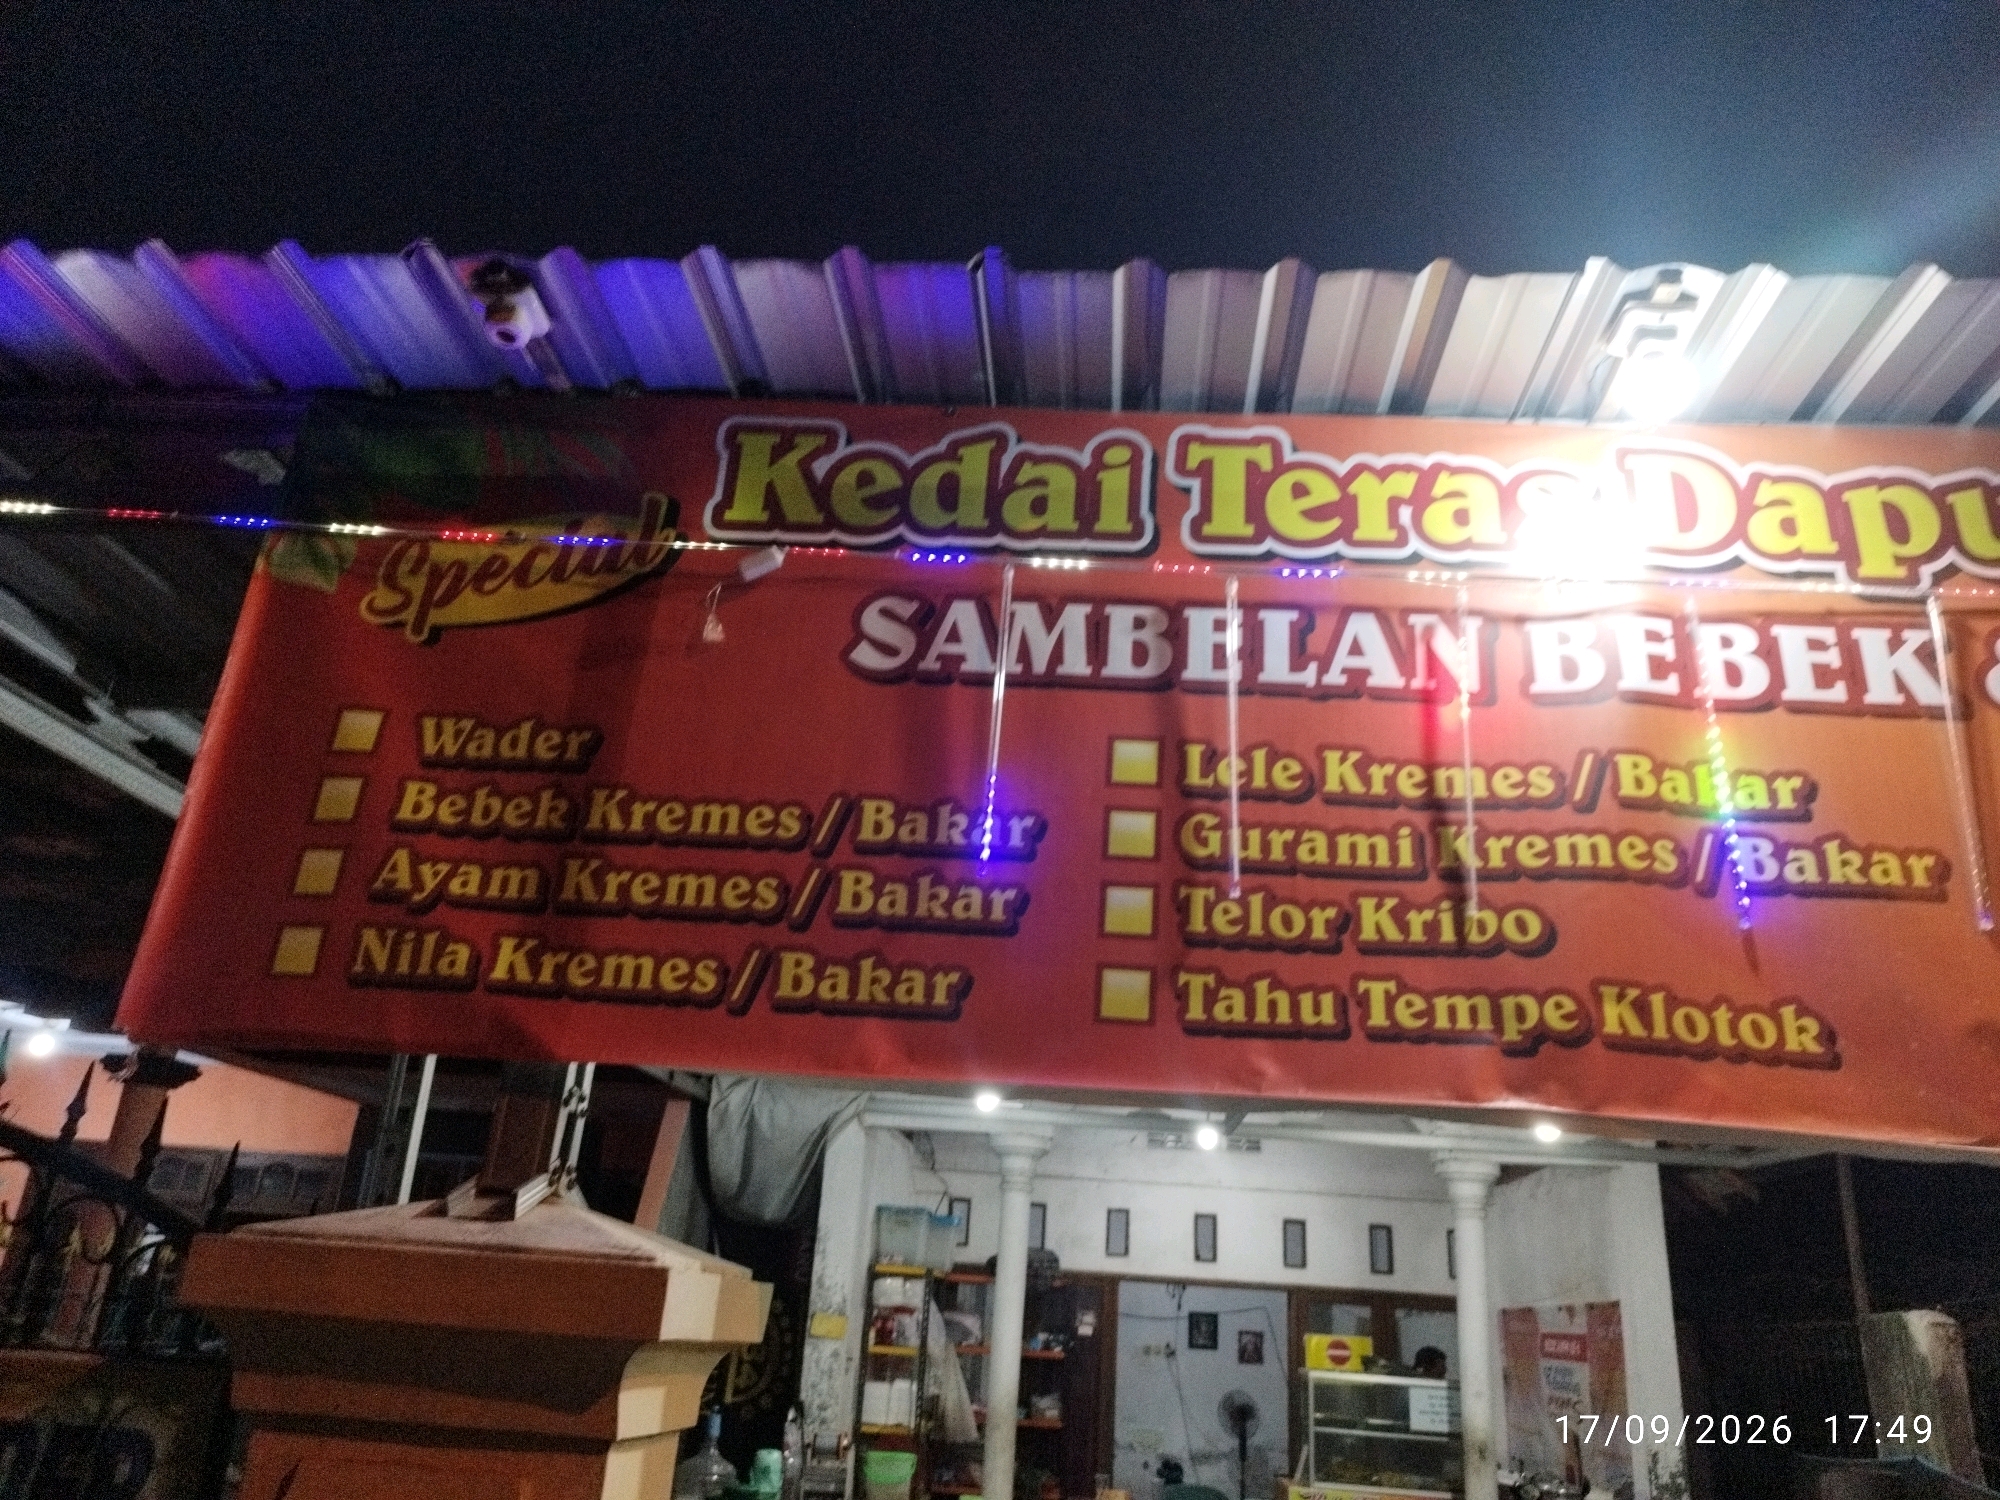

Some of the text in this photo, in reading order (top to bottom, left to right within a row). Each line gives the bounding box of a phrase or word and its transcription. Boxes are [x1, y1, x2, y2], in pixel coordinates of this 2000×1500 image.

[720, 427, 1139, 540] Kedai
[850, 598, 1483, 693] SAMBELAN
[1526, 612, 1942, 708] BEBEK
[420, 715, 592, 764] Wader
[1183, 743, 1304, 792] Lele
[1321, 749, 1555, 798] Kremes
[395, 780, 570, 827] Bebek
[588, 790, 803, 842] Kremes
[857, 800, 1037, 852] Bakar
[1180, 815, 1413, 868] Gurami
[1440, 826, 1680, 876] Kremes
[1740, 836, 1936, 890] Bakar
[372, 848, 540, 907] Ayam
[560, 858, 781, 913] Kremes
[835, 870, 1018, 922] Bakar
[1180, 887, 1543, 946] Telor Kribo
[355, 927, 472, 978] Nila
[490, 937, 720, 995] Kremes
[775, 952, 962, 1008] Bakar
[1178, 972, 1823, 1055] Tahu Tempe Klotok
